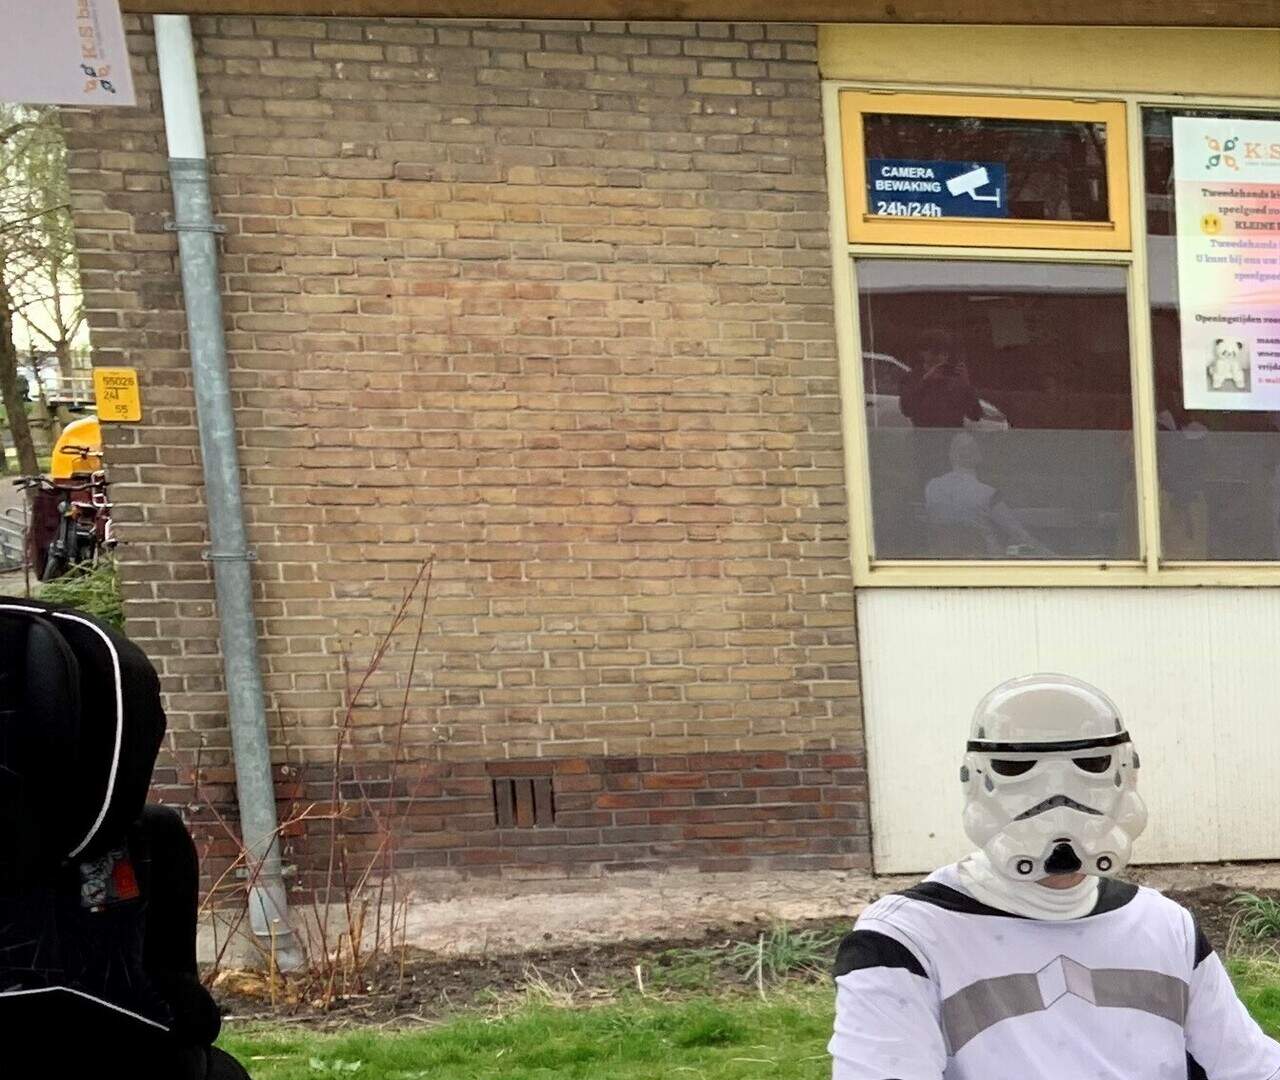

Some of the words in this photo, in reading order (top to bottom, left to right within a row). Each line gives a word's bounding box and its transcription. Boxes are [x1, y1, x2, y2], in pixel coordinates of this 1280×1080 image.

[881, 166, 935, 179] CAMERA
[875, 180, 942, 193] BEWAKING
[877, 201, 942, 217] 24h/24h
[1235, 221, 1275, 230] KLEINE
